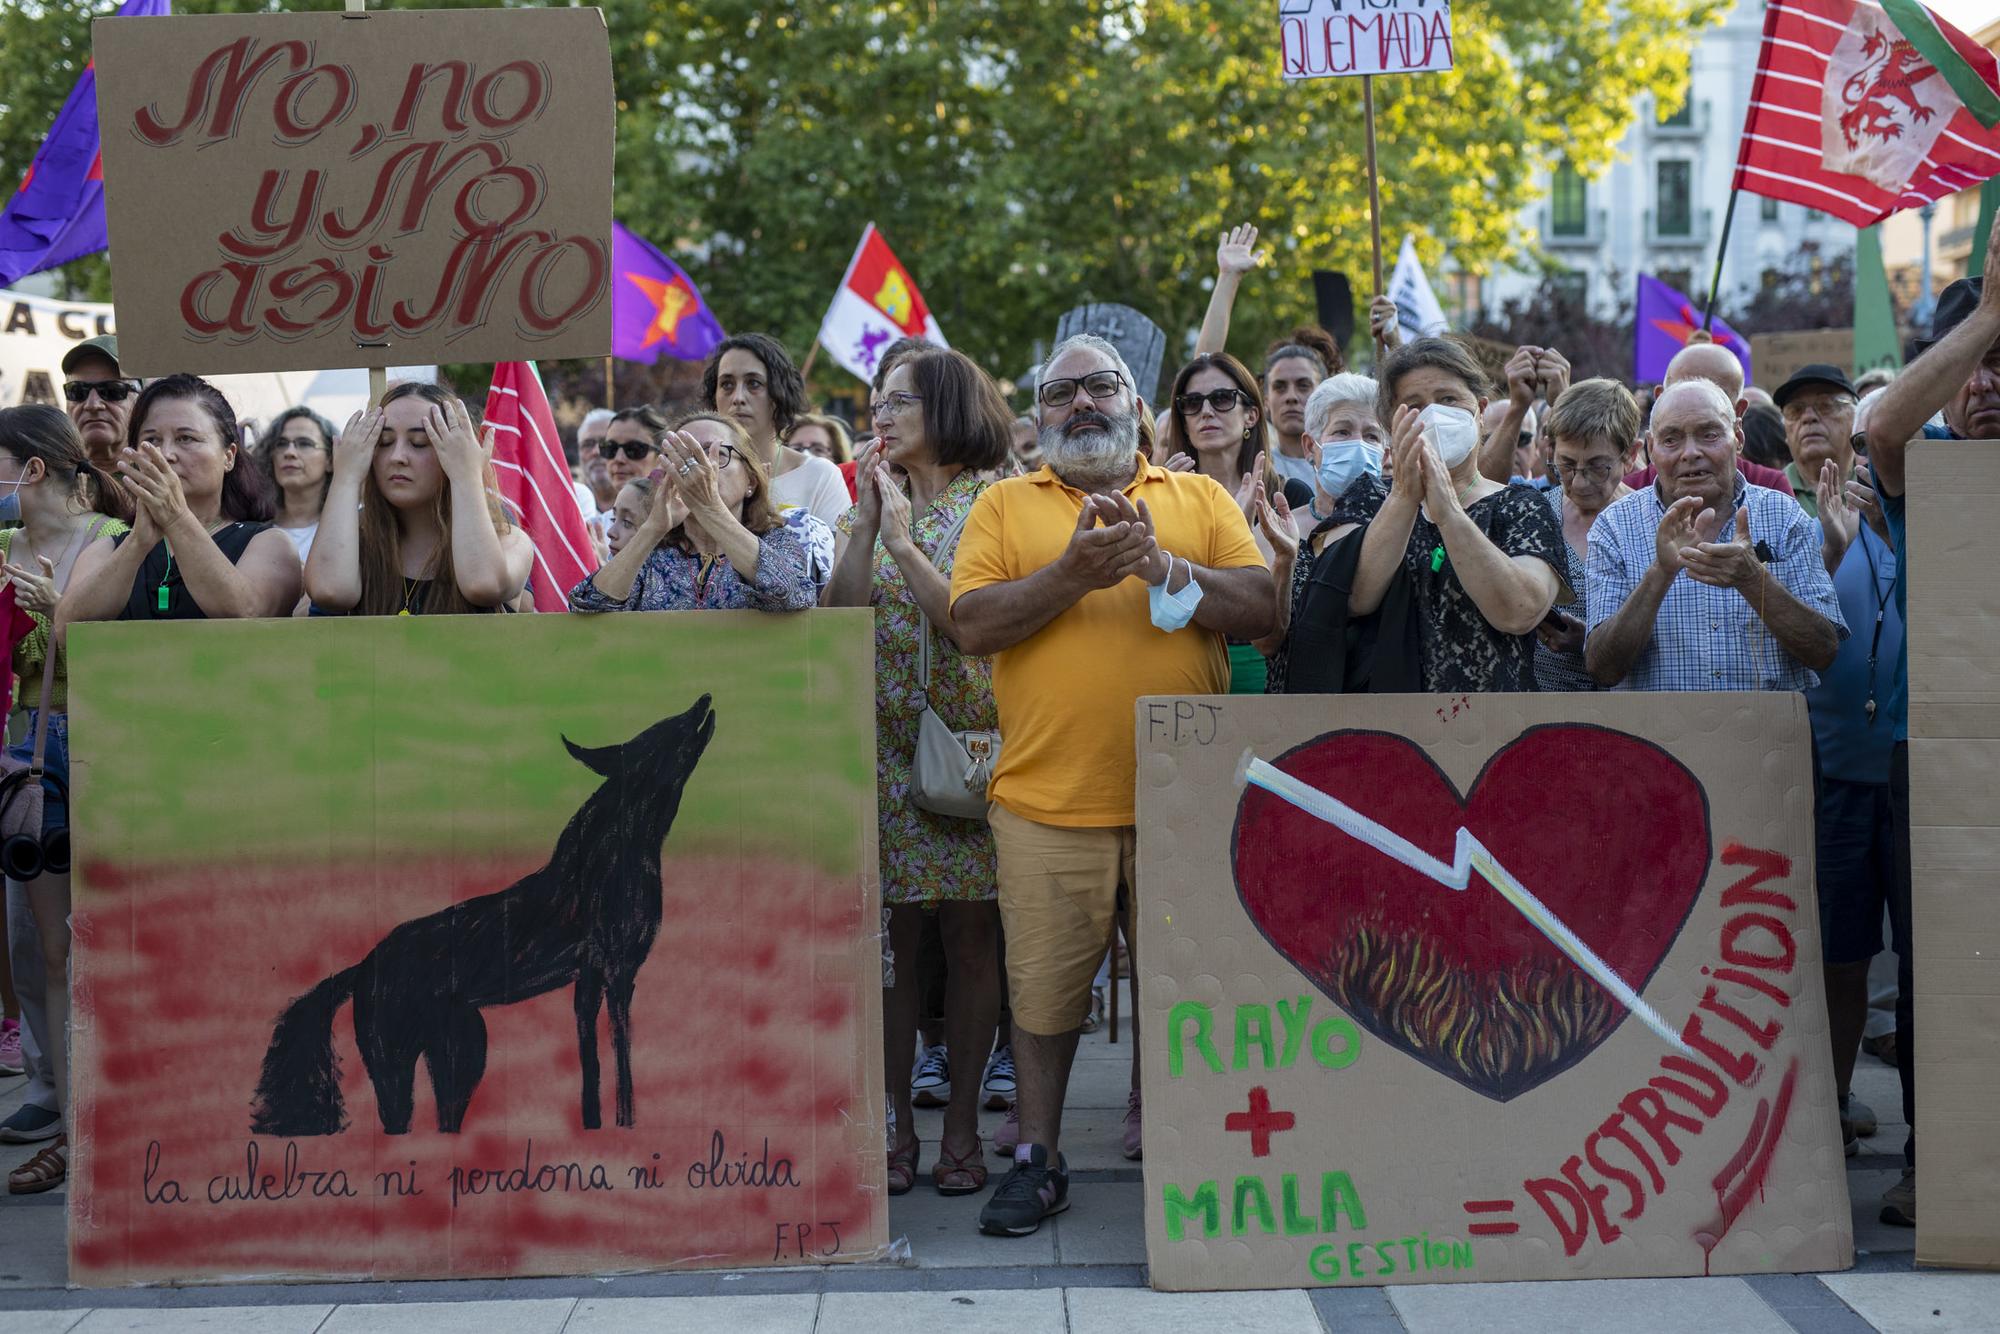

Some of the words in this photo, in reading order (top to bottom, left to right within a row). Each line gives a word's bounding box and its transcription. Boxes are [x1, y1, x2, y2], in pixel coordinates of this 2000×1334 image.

[1281, 10, 1453, 75] QUEMADA
[391, 59, 550, 138] no
[219, 168, 328, 264] y
[320, 140, 546, 248] No
[392, 222, 606, 340] No
[1168, 996, 1361, 1078] RAYO
[144, 1141, 189, 1204] la
[208, 1141, 358, 1201] culebra
[373, 1160, 424, 1196] ni
[447, 1138, 614, 1208] perdona
[628, 1152, 664, 1190] ni
[688, 1129, 801, 1189] olvida
[1163, 1171, 1368, 1241] MALA
